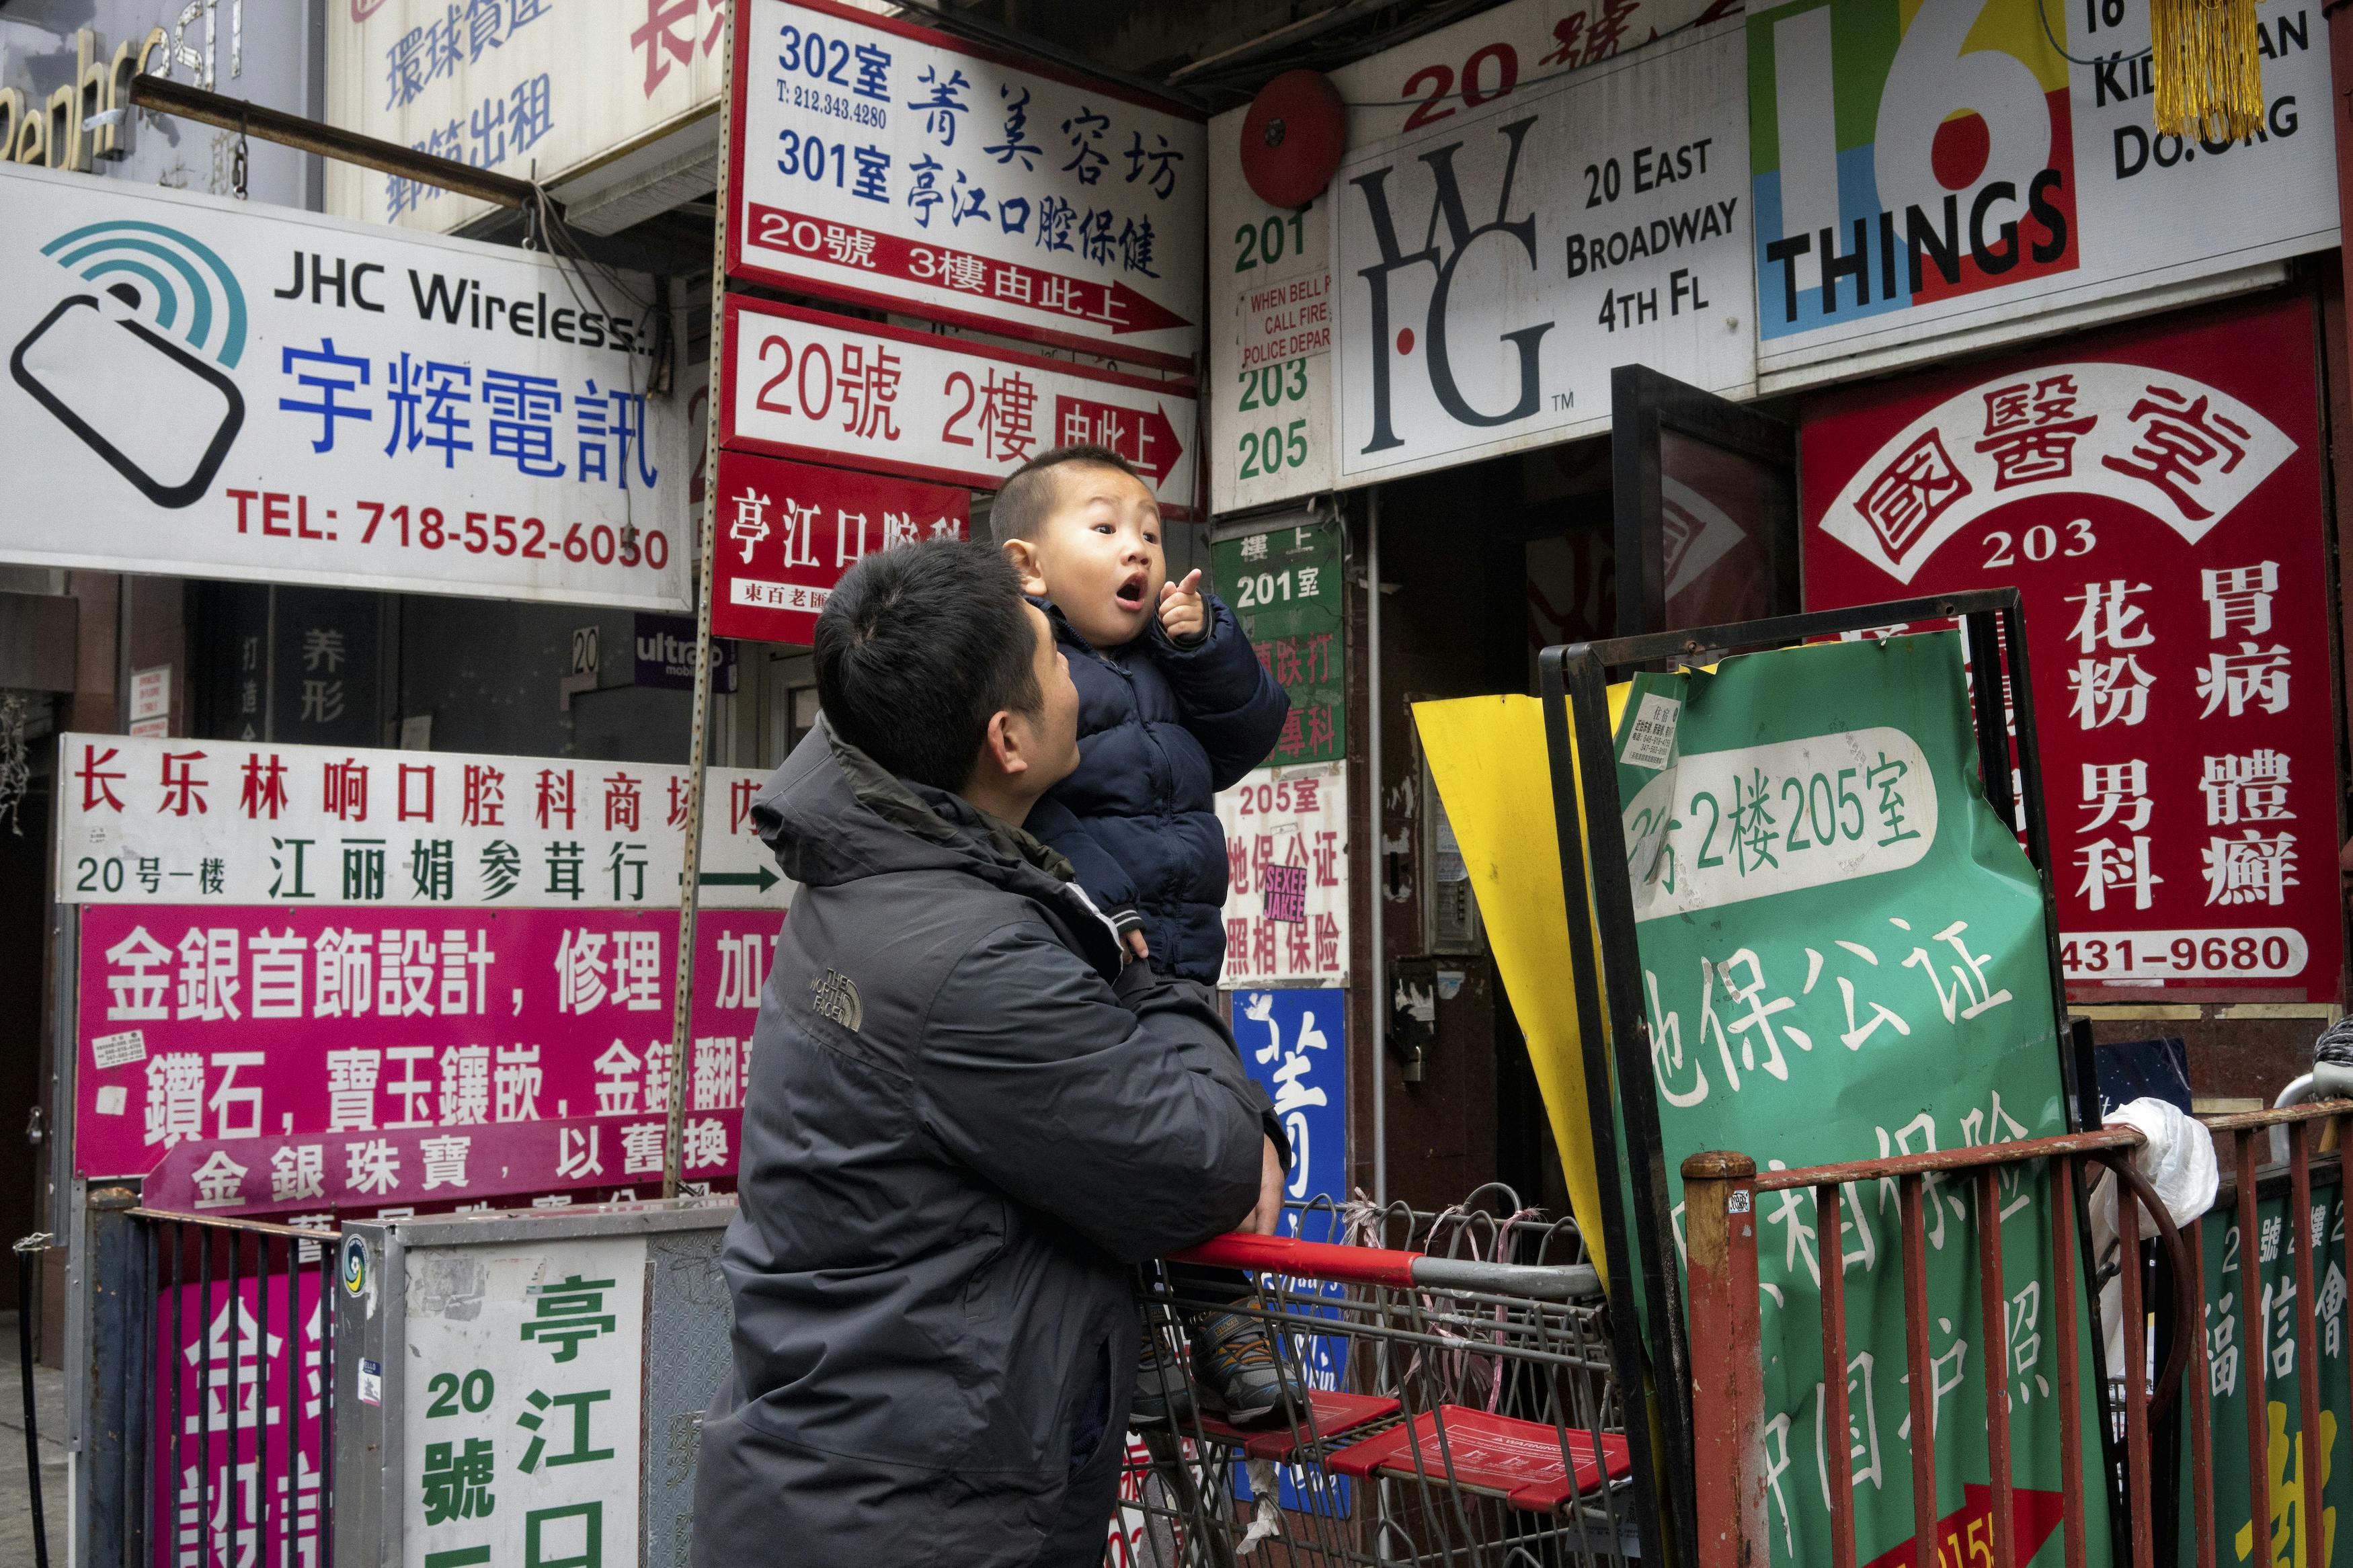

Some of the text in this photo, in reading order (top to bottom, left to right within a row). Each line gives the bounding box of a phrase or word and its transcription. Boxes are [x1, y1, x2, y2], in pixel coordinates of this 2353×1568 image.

[779, 25, 891, 102] 302室
[795, 86, 885, 128] 212.343.4280
[778, 129, 890, 204] 301室
[1584, 157, 1620, 208] 20
[760, 214, 875, 268] 20號
[1235, 210, 1304, 273] 201
[1767, 169, 2067, 322] THINGS
[274, 251, 384, 313] JHC
[1251, 287, 1286, 313] WHEN
[1290, 279, 1321, 303] BELL
[1265, 302, 1326, 334] CALL FIRE
[1244, 342, 1286, 366] POLICE
[757, 335, 901, 440] 20號
[943, 368, 1038, 462] 2樓
[1238, 357, 1307, 411] 203
[1552, 389, 1574, 411] TM
[279, 337, 657, 489] 宇辉電訊
[1239, 419, 1307, 480] 205
[227, 489, 669, 571] TEL: 718-552-6050
[1983, 519, 2096, 568] 203
[1237, 567, 1319, 608] 201室
[575, 629, 597, 673] 20
[2065, 579, 2157, 730] 花粉
[2196, 561, 2290, 719] 胃病
[1240, 777, 1320, 815] 205室
[2073, 757, 2163, 910] 男科
[76, 856, 225, 895] 20号一楼
[1266, 866, 1306, 895] SEXEE
[1264, 894, 1305, 922] JAKEE
[715, 931, 779, 1008] 加
[809, 974, 844, 1008] NORTH
[827, 967, 848, 993] THE
[812, 995, 841, 1021] FACE
